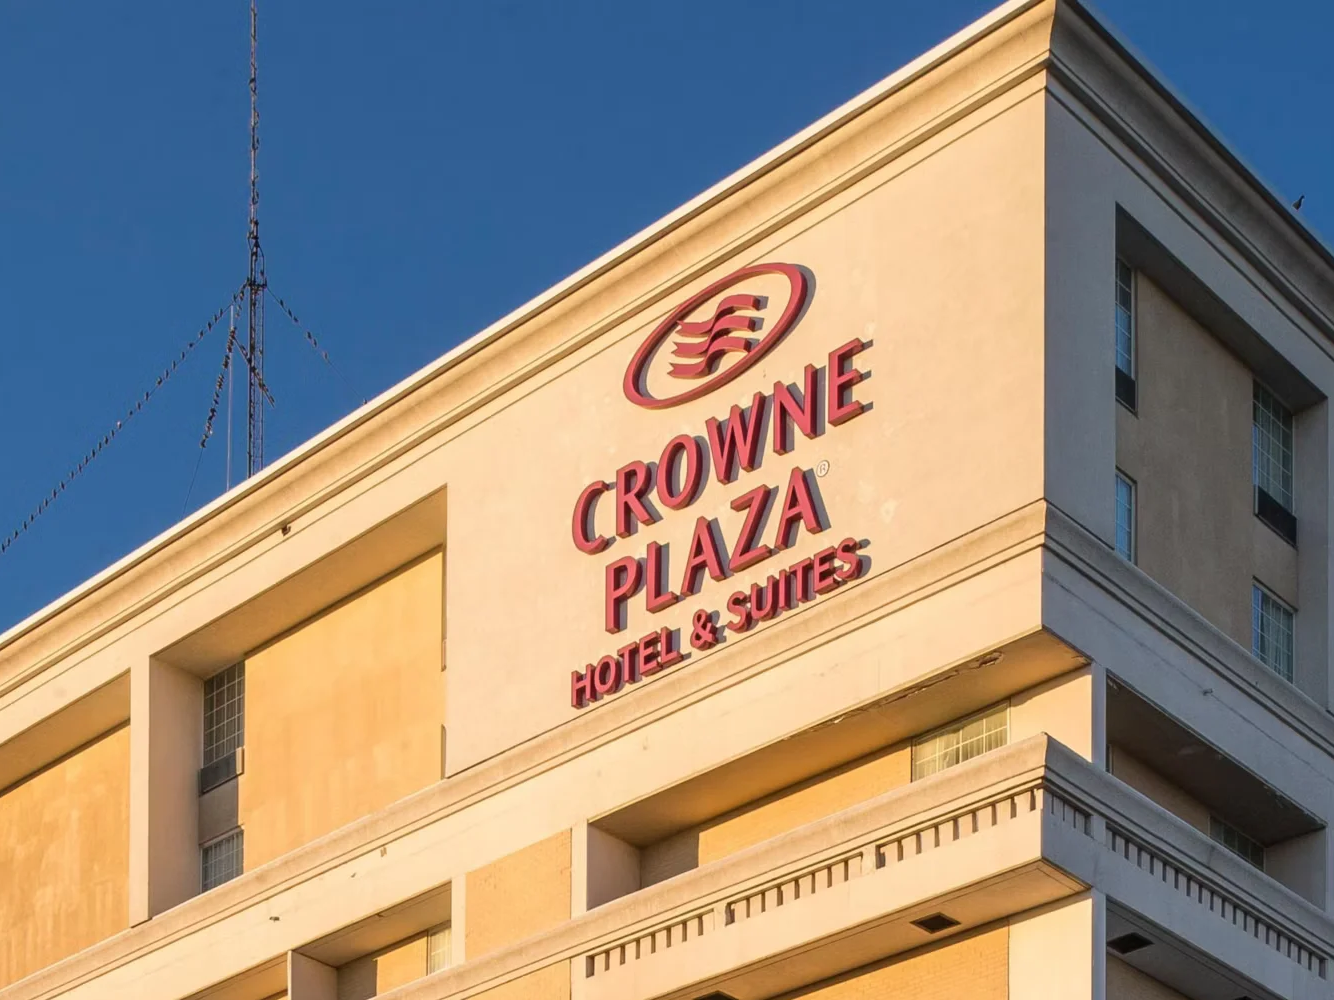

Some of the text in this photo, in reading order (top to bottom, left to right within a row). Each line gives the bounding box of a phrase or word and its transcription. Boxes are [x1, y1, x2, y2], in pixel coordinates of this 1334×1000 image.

[572, 337, 868, 555] CROWNE
[571, 537, 865, 709] HOTEL & SUITES
[605, 466, 822, 634] PLAZA
